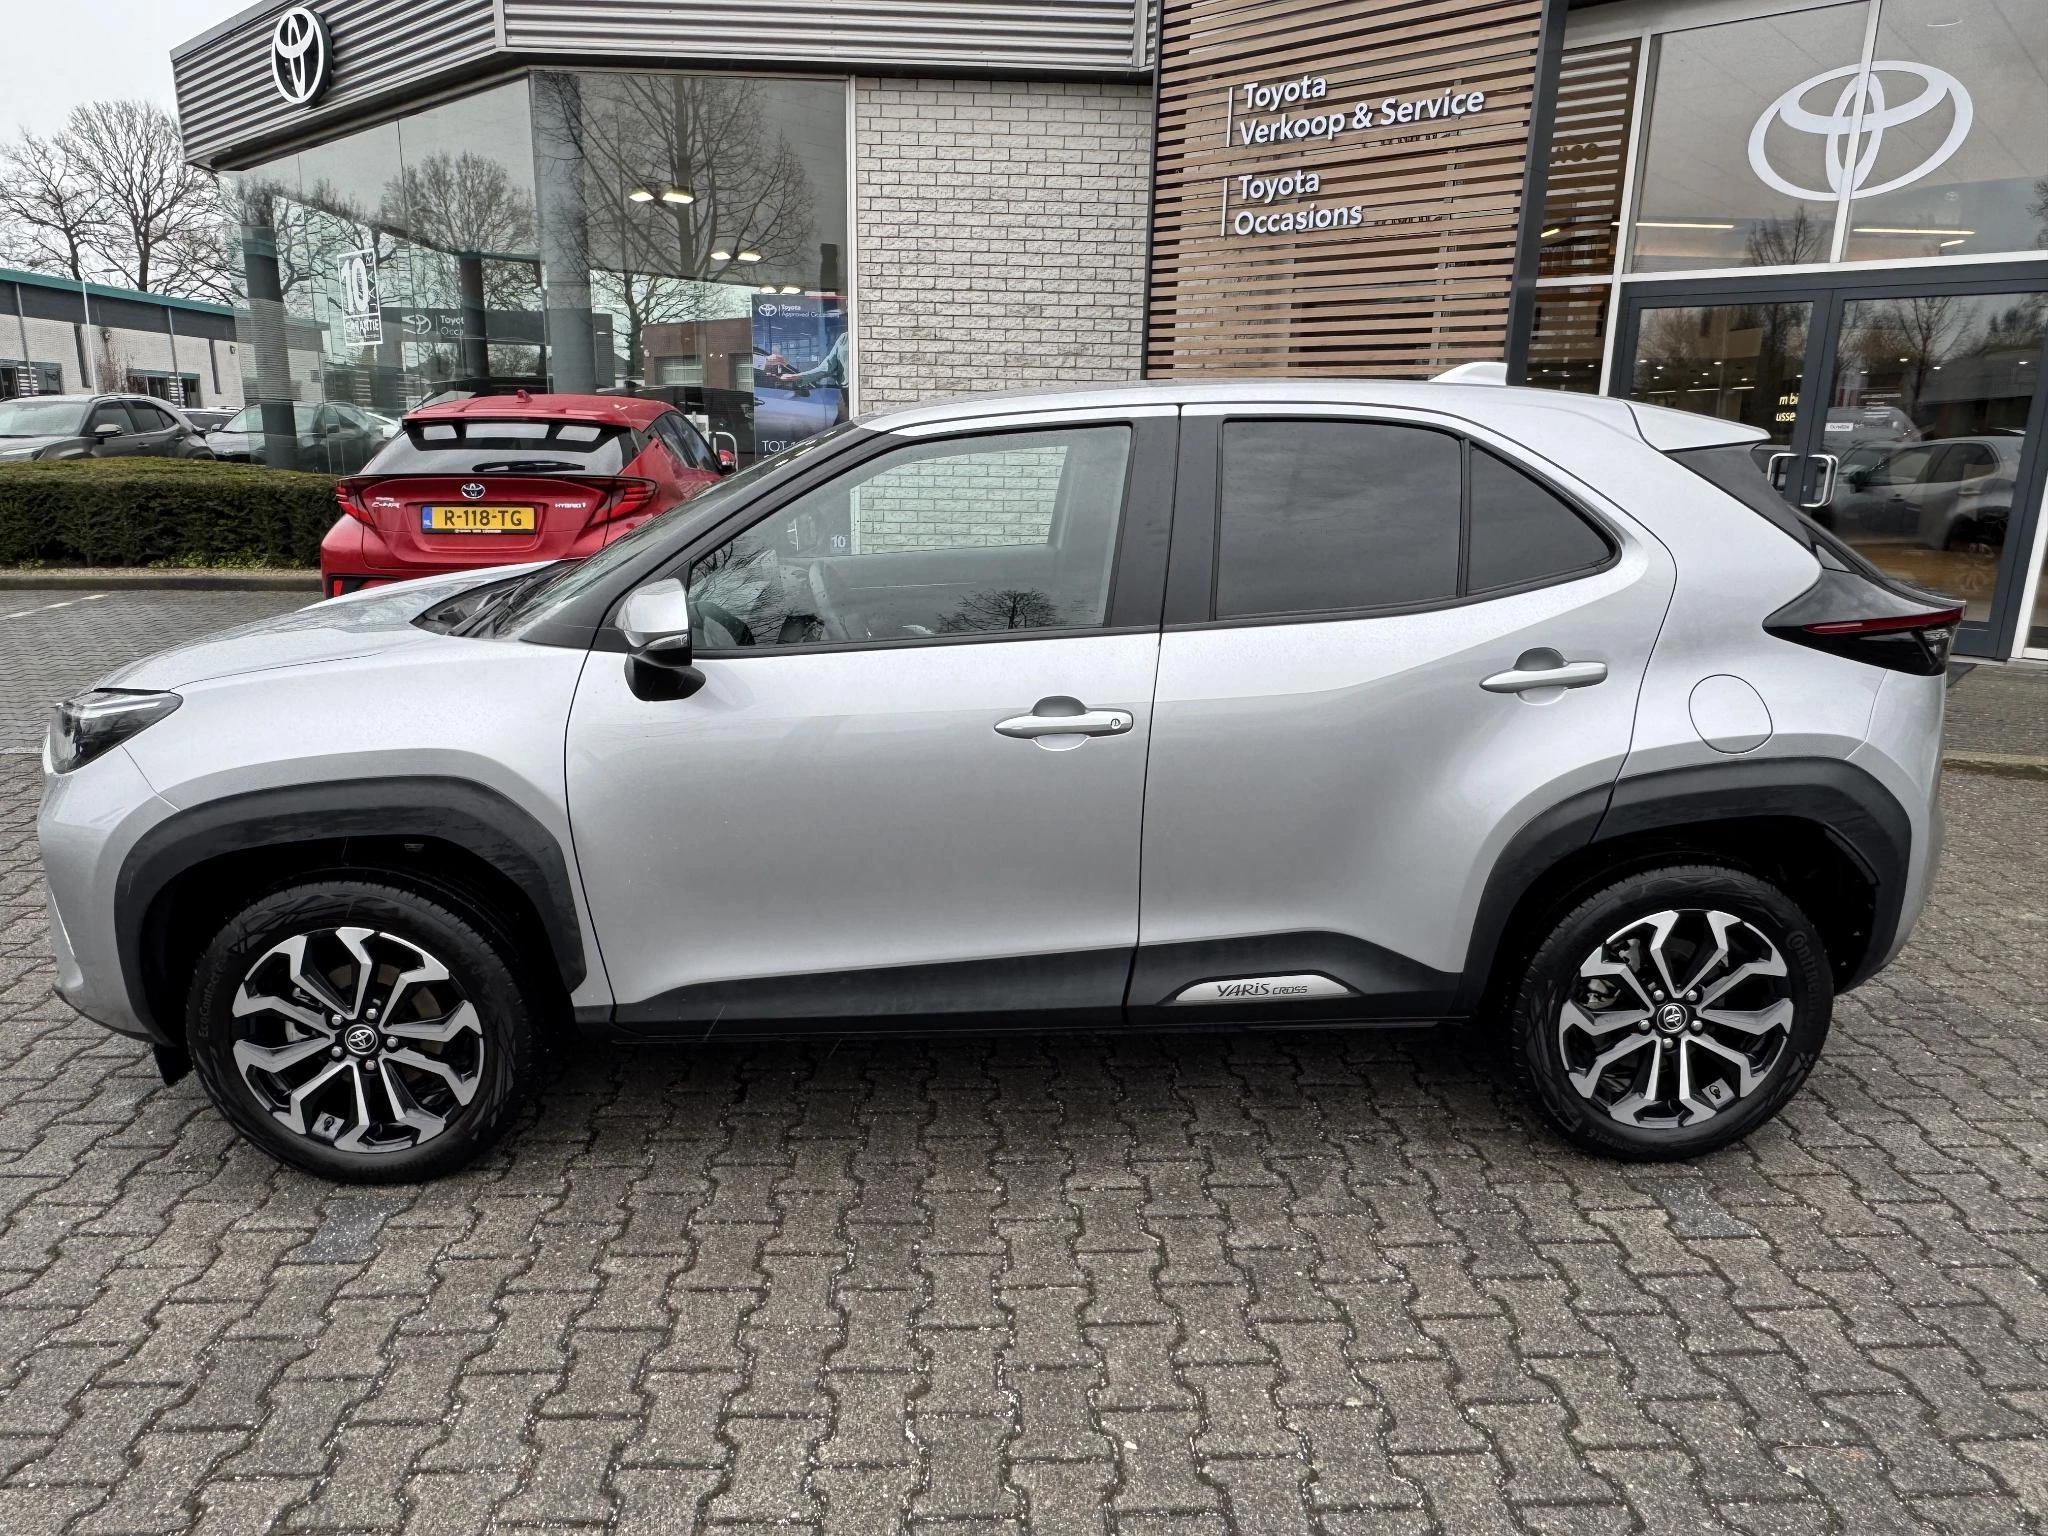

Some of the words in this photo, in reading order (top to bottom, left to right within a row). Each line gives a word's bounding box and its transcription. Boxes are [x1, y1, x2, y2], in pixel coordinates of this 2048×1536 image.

[1244, 75, 1327, 111] Toyota
[1240, 112, 1345, 145] Verkoop
[1352, 102, 1372, 129] &
[1381, 89, 1485, 126] Service
[1238, 169, 1320, 203] Toyota
[1234, 202, 1363, 236] Occasions
[341, 257, 368, 314] 10
[781, 303, 801, 311] Toyota
[440, 314, 464, 326] Toyot
[762, 440, 787, 452] TOT
[444, 508, 522, 527] R-118-TG
[832, 535, 845, 548] 10
[1272, 985, 1308, 995] CROSS
